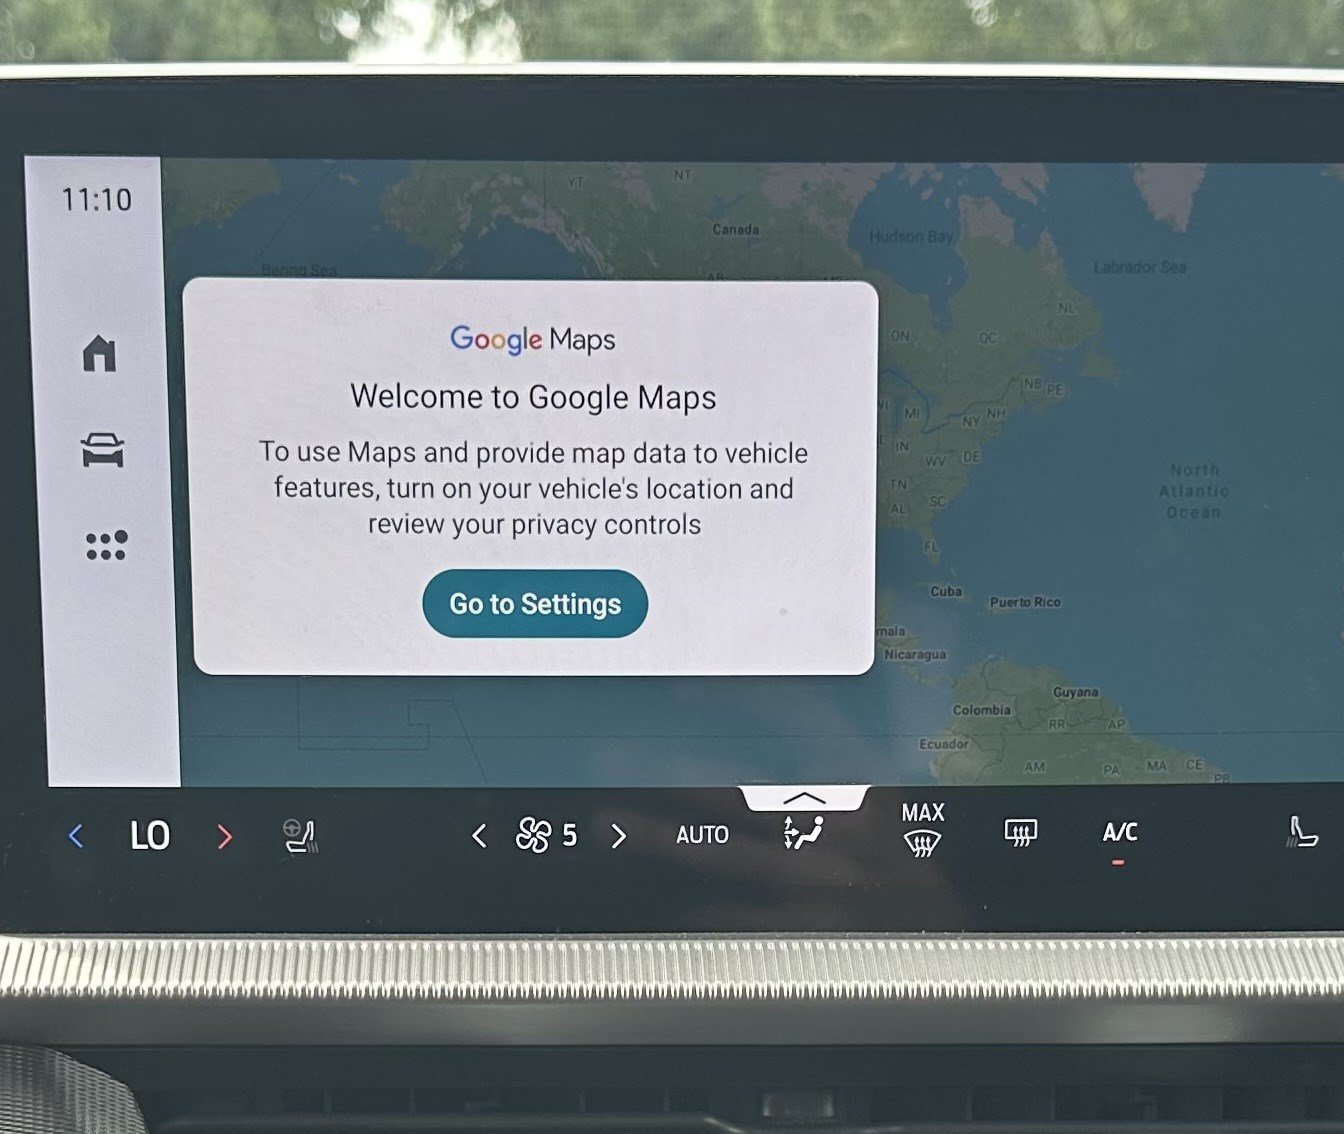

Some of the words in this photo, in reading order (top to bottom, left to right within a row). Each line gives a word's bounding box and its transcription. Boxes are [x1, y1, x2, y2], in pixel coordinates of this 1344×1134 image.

[673, 170, 692, 182] NT
[62, 187, 133, 212] 11:10
[712, 223, 761, 237] Canada
[869, 229, 924, 244] Hudson
[927, 230, 954, 247] Bay
[1093, 260, 1156, 274] Labrador
[1160, 260, 1186, 274] Sea
[1058, 302, 1075, 315] NL
[450, 324, 543, 357] Google
[550, 327, 616, 356] Maps
[890, 330, 910, 343] ON
[979, 331, 998, 345] QC
[350, 382, 483, 410] Welcome
[491, 385, 520, 410] to
[528, 383, 629, 416] Google
[639, 384, 717, 416] Maps
[905, 408, 920, 420] MI
[987, 408, 1006, 419] NH
[962, 416, 981, 428] NY
[259, 440, 290, 464] To
[297, 446, 341, 464] use
[348, 441, 417, 470] Maps
[424, 440, 469, 464] and
[476, 440, 565, 471] provide
[572, 446, 626, 470] map
[633, 441, 686, 465] data
[693, 443, 718, 465] to
[725, 441, 809, 465] vehicle
[963, 451, 980, 463] DE
[1170, 462, 1220, 477] North
[273, 475, 380, 503] features,
[387, 479, 435, 501] turn
[442, 482, 472, 501] on
[479, 482, 532, 505] your
[538, 476, 639, 501] vehicle's
[646, 476, 742, 501] location
[749, 476, 794, 501] and
[1159, 484, 1230, 498] Atlantic
[929, 496, 946, 507] SC
[890, 503, 906, 515] AL
[1166, 505, 1221, 519] Ocean
[368, 513, 444, 536] review
[451, 517, 505, 541] your
[512, 513, 597, 541] privacy
[604, 512, 702, 537] controls
[924, 541, 938, 553] FL
[930, 585, 963, 598] Cuba
[449, 591, 487, 617] Go
[491, 593, 516, 617] to
[521, 590, 622, 623] Settings
[990, 597, 1031, 608] Puerto
[1034, 596, 1062, 608] Rico
[884, 649, 947, 663] Nicaragua
[1053, 686, 1099, 700] Guyana
[953, 703, 1011, 716] Colombia
[919, 738, 970, 750] Ecuador
[1024, 761, 1046, 773] AM
[1147, 760, 1167, 771] MA
[1185, 760, 1203, 771] CE
[901, 803, 945, 823] MAX
[130, 820, 170, 850] LO
[562, 823, 577, 847] 5
[676, 824, 730, 845] AUTO
[1102, 821, 1138, 844] A/C
